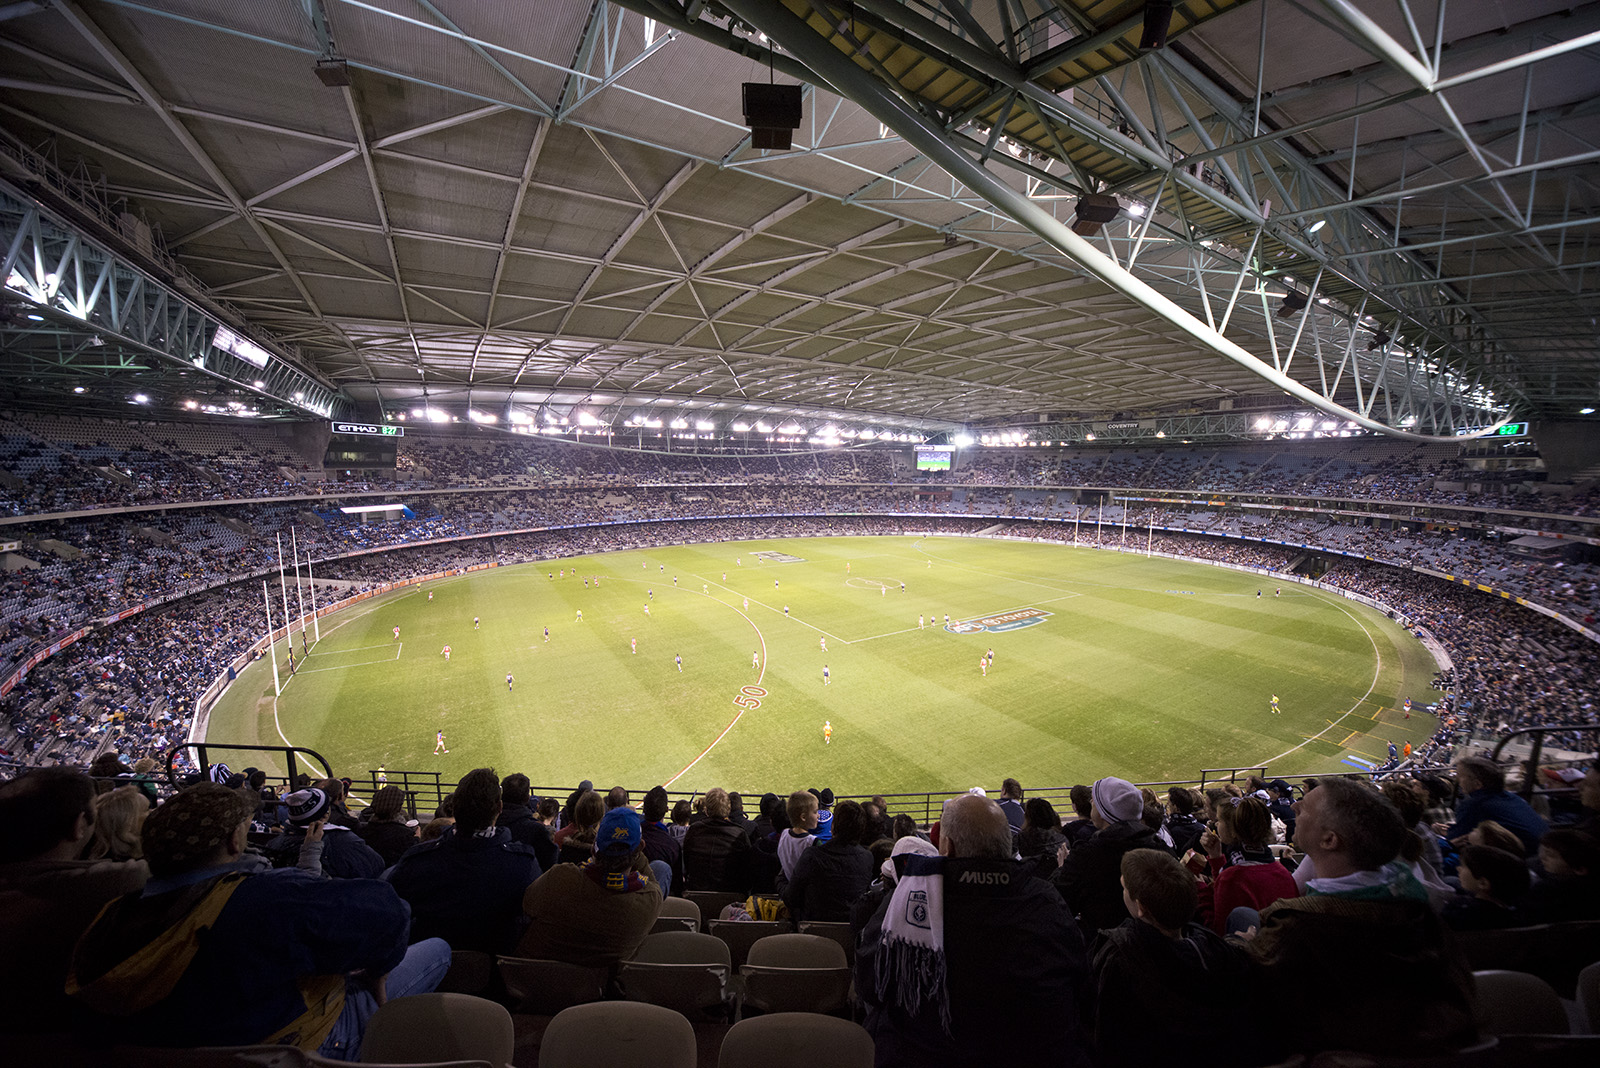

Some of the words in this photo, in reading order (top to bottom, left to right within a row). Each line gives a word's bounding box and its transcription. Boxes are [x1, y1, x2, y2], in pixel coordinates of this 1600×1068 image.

[337, 424, 378, 433] ETIHAD
[732, 685, 768, 710] 50
[959, 871, 1010, 885] MUSTO
